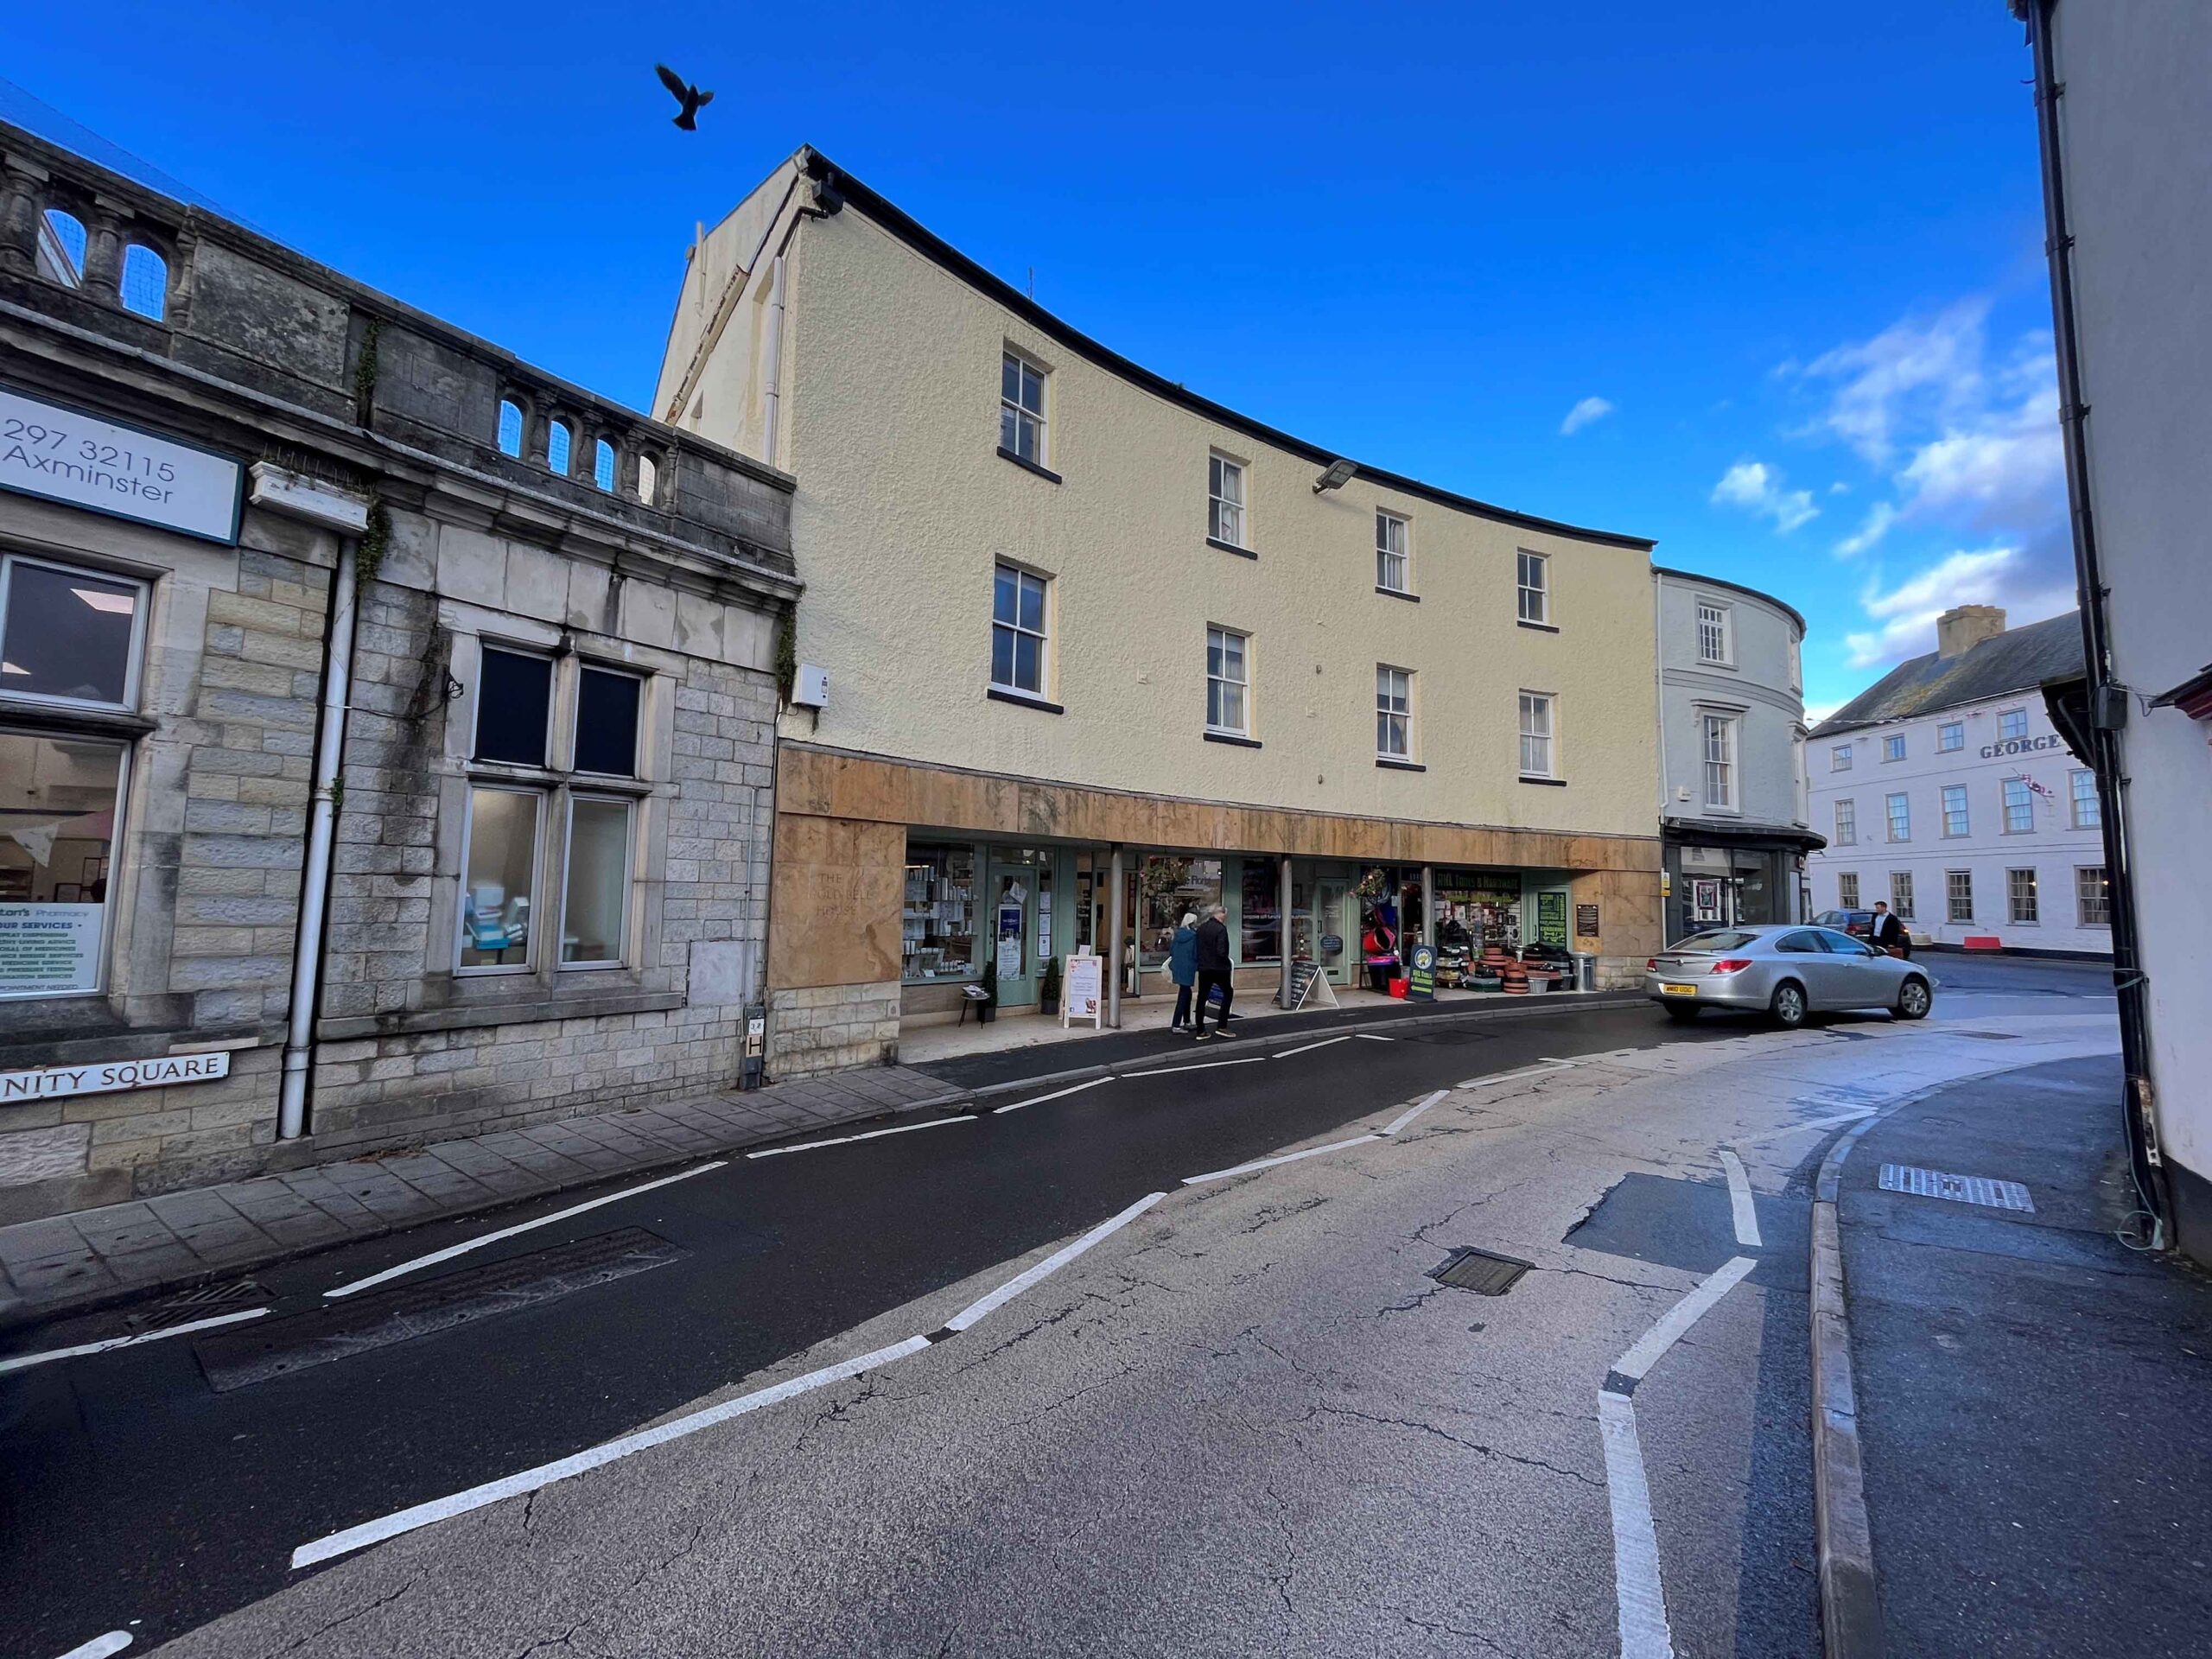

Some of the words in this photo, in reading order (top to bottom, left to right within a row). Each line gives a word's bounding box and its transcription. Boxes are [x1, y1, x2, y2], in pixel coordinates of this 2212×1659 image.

[4, 418, 67, 450] 297
[79, 440, 175, 482] 32115
[3, 444, 174, 504] Axminster
[1980, 734, 2060, 759] GEORGE
[748, 1035, 762, 1055] H
[4, 1071, 87, 1097] NITY
[100, 1057, 219, 1088] SQUARE
